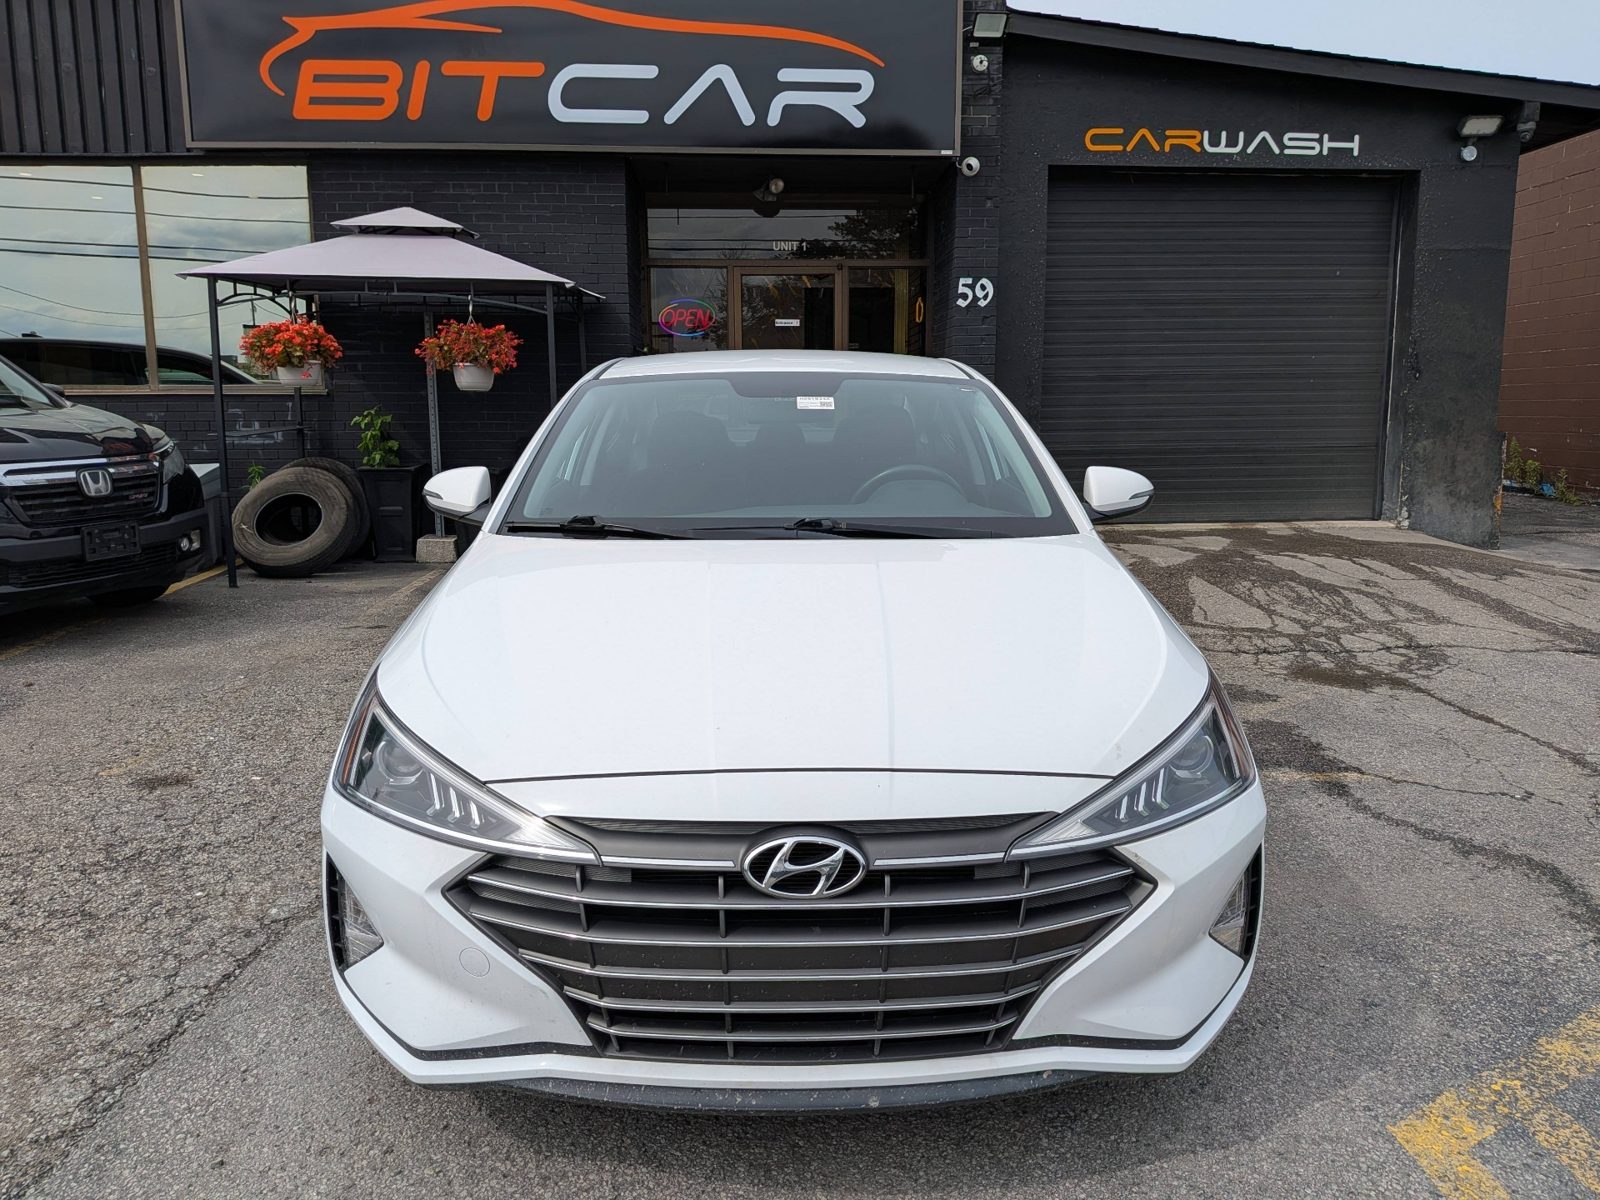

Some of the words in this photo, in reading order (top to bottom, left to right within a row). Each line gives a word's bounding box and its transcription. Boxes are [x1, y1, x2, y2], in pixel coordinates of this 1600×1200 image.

[292, 59, 875, 128] BITCAR
[1084, 127, 1360, 157] CARWASH
[773, 241, 800, 251] UNIT
[801, 241, 807, 251] 1
[956, 277, 994, 308] 59
[661, 308, 711, 328] OPEN
